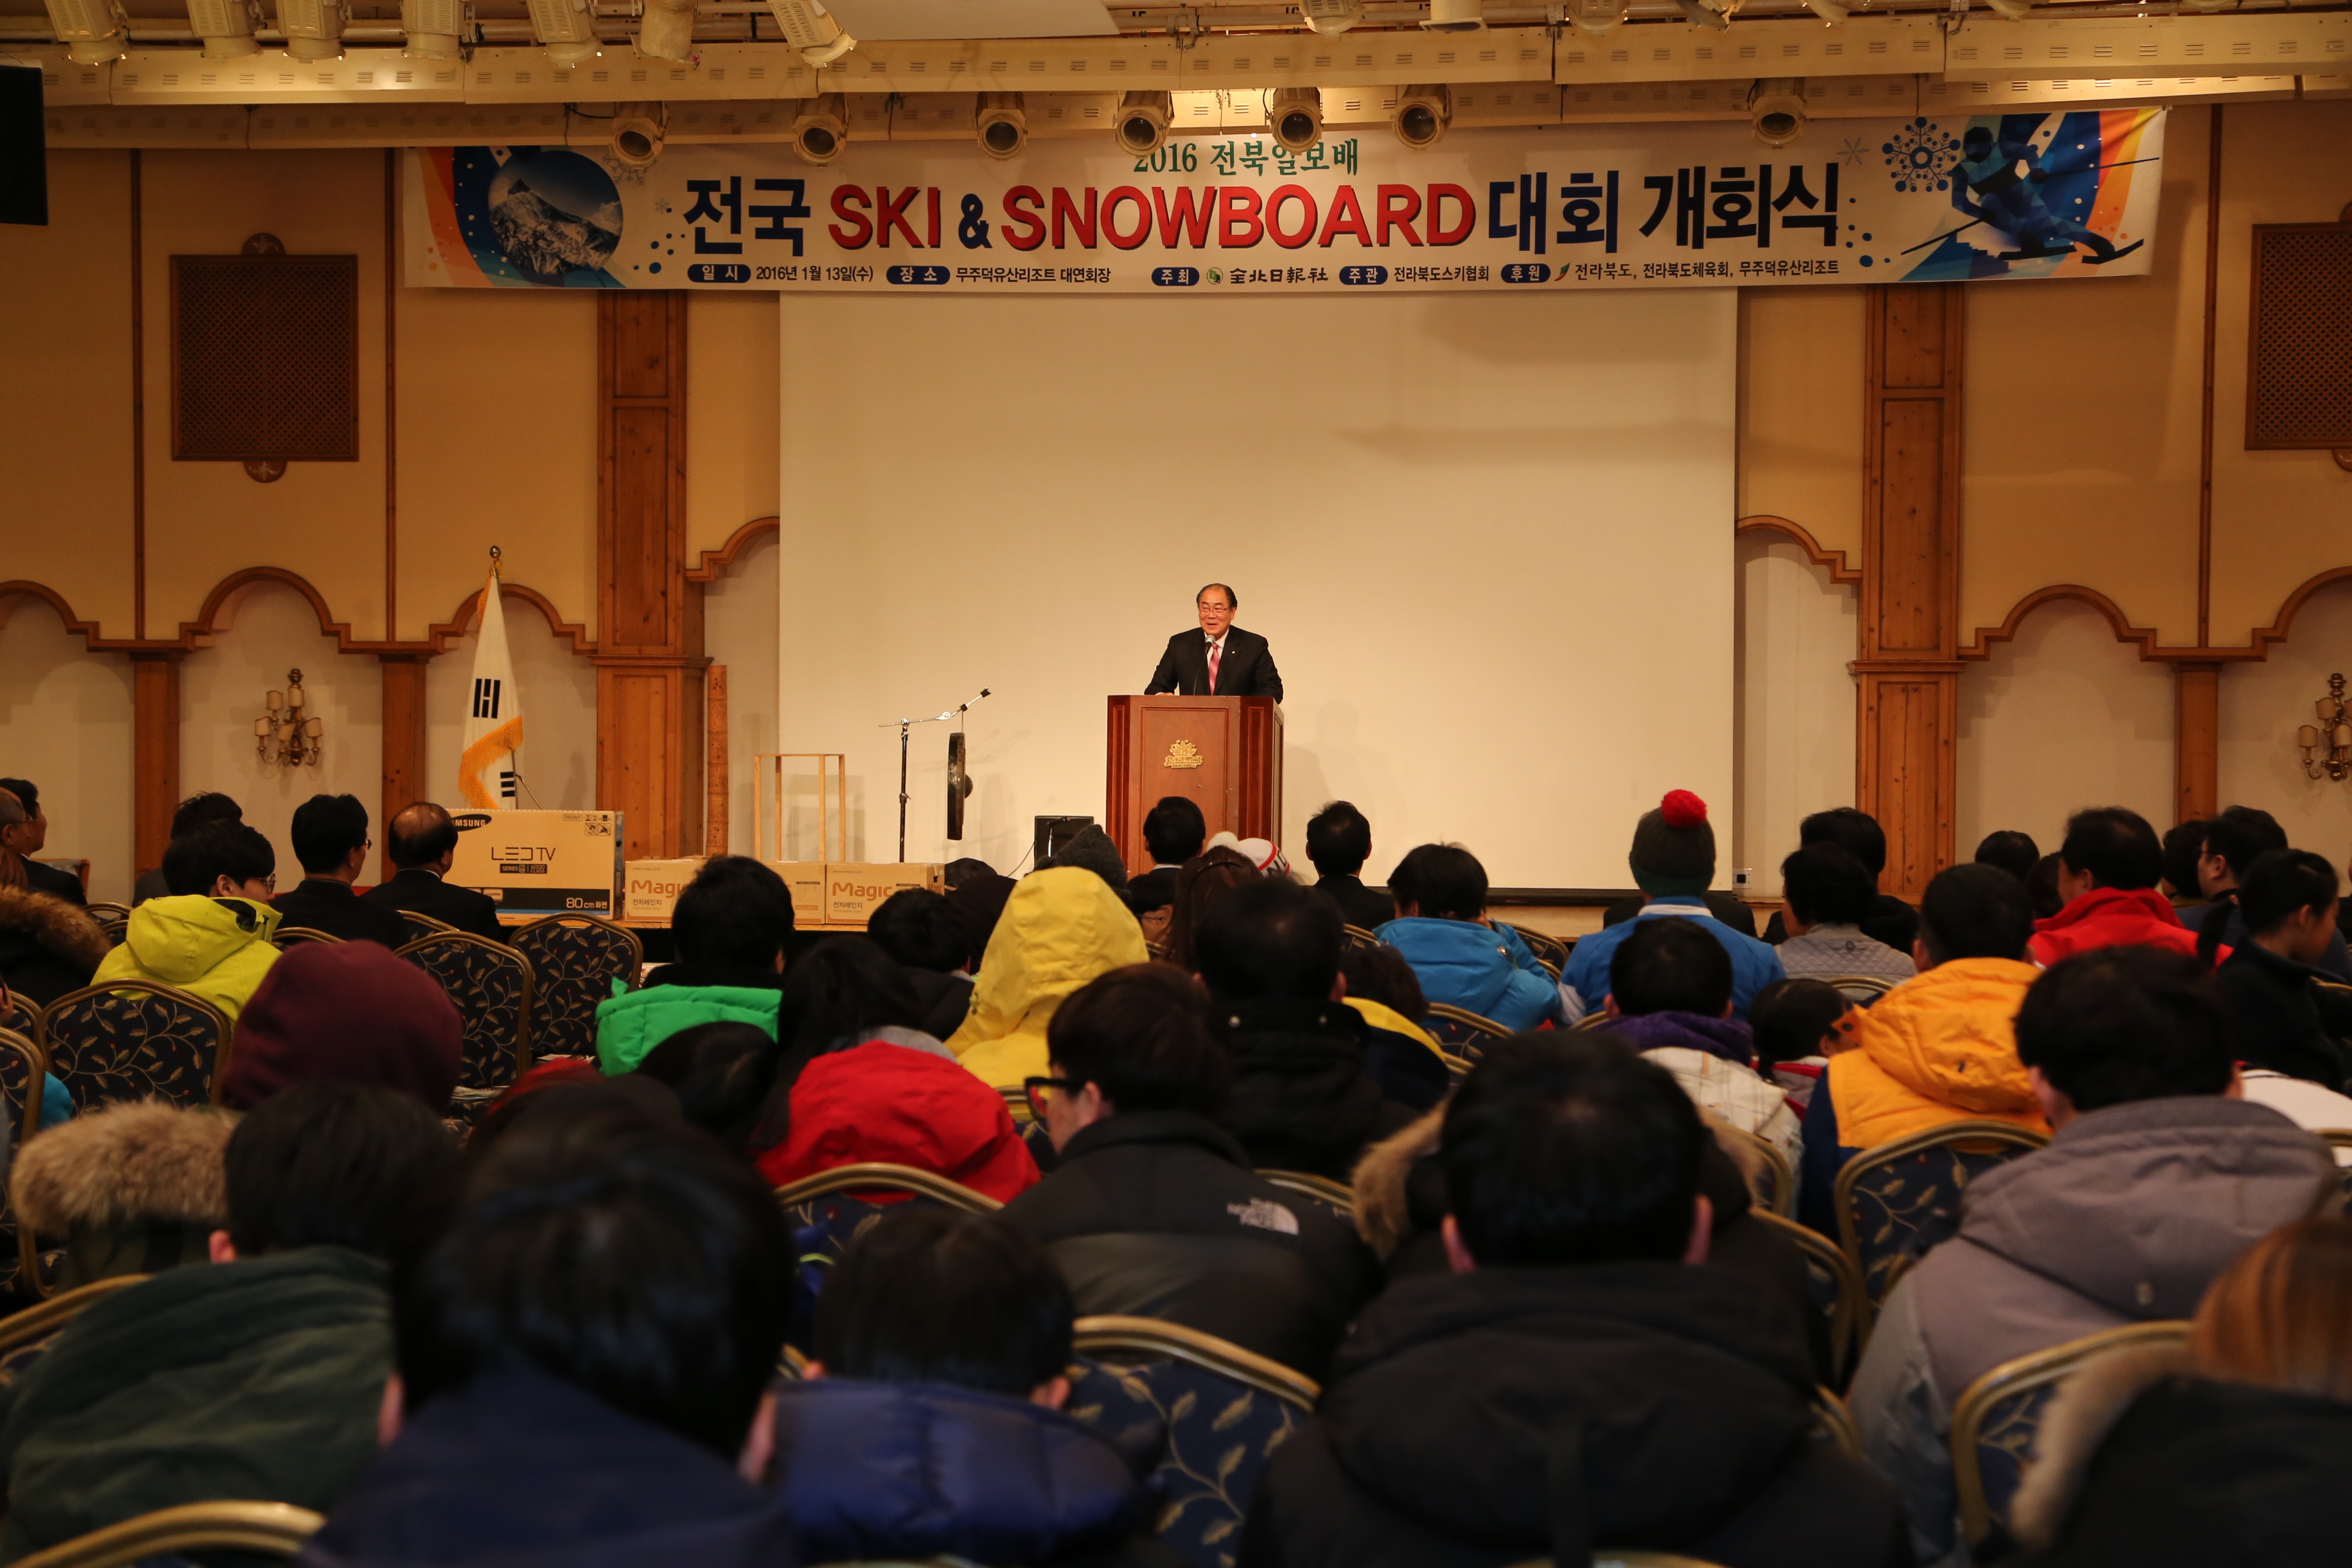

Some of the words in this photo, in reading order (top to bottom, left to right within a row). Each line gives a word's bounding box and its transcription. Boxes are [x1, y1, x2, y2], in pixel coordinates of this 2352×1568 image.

[1210, 138, 1358, 177] 전북일보배
[682, 175, 811, 257] 전국
[828, 184, 941, 250] SKI
[957, 193, 993, 250] &
[1001, 183, 1476, 251] SNOWBOARD
[1488, 170, 1620, 255] 대회
[1638, 162, 1839, 250] 개회식
[756, 266, 798, 282] 2016년
[802, 265, 821, 282] 1월
[826, 265, 874, 282] 13일(수)
[956, 267, 1056, 283] 무주덕유산리조트
[1060, 268, 1112, 283] 대연회장
[1394, 266, 1489, 282] 전라북도스키협회
[1575, 262, 1637, 280] 전라북도,
[1643, 261, 1734, 279] 전라북도체육회,
[1739, 259, 1839, 277] 무주덕유산리조트
[451, 819, 485, 827] MSUNG
[491, 847, 533, 861] LED
[535, 847, 556, 861] TV
[631, 879, 682, 899] Magi
[832, 882, 892, 901] Magic
[595, 901, 607, 909] 화면
